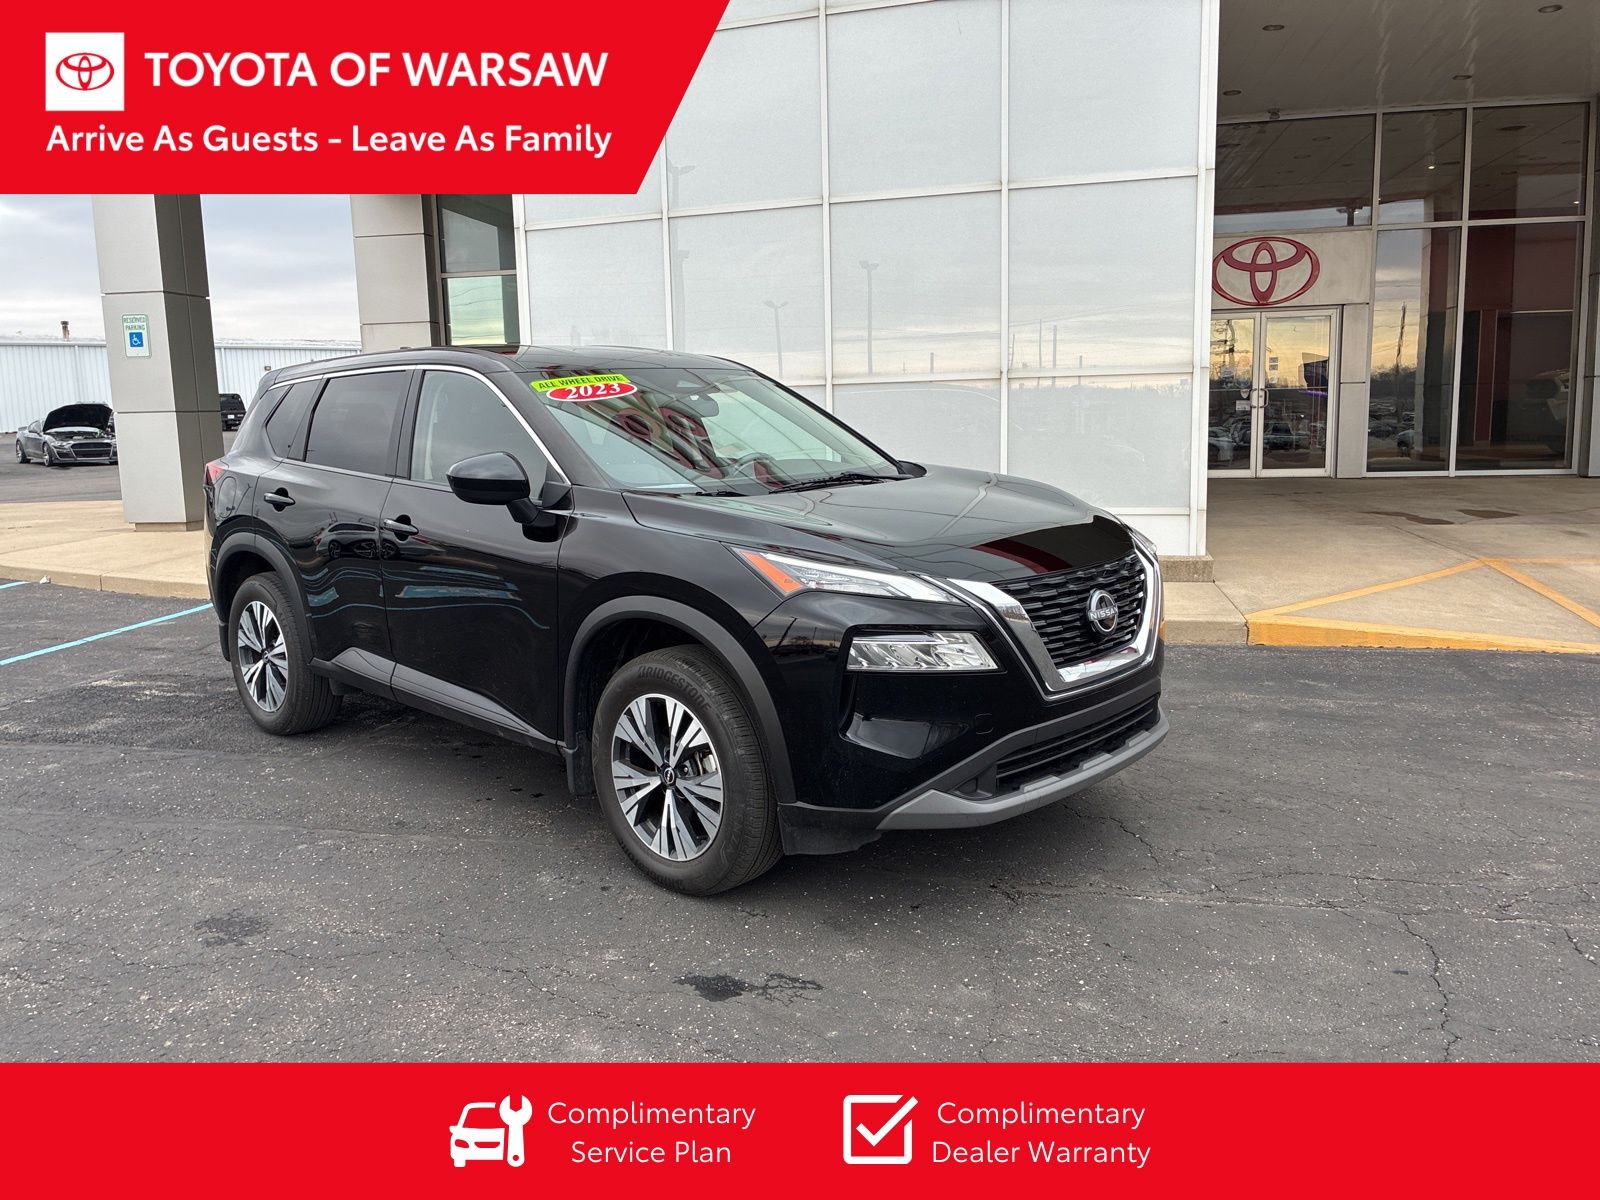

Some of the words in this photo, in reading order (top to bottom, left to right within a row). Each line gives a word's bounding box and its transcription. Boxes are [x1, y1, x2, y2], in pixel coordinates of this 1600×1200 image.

[560, 377, 592, 386] WHEEL
[564, 383, 621, 399] 2023
[1090, 606, 1118, 620] NISSAN
[638, 665, 712, 711] BRIDGESTONE
